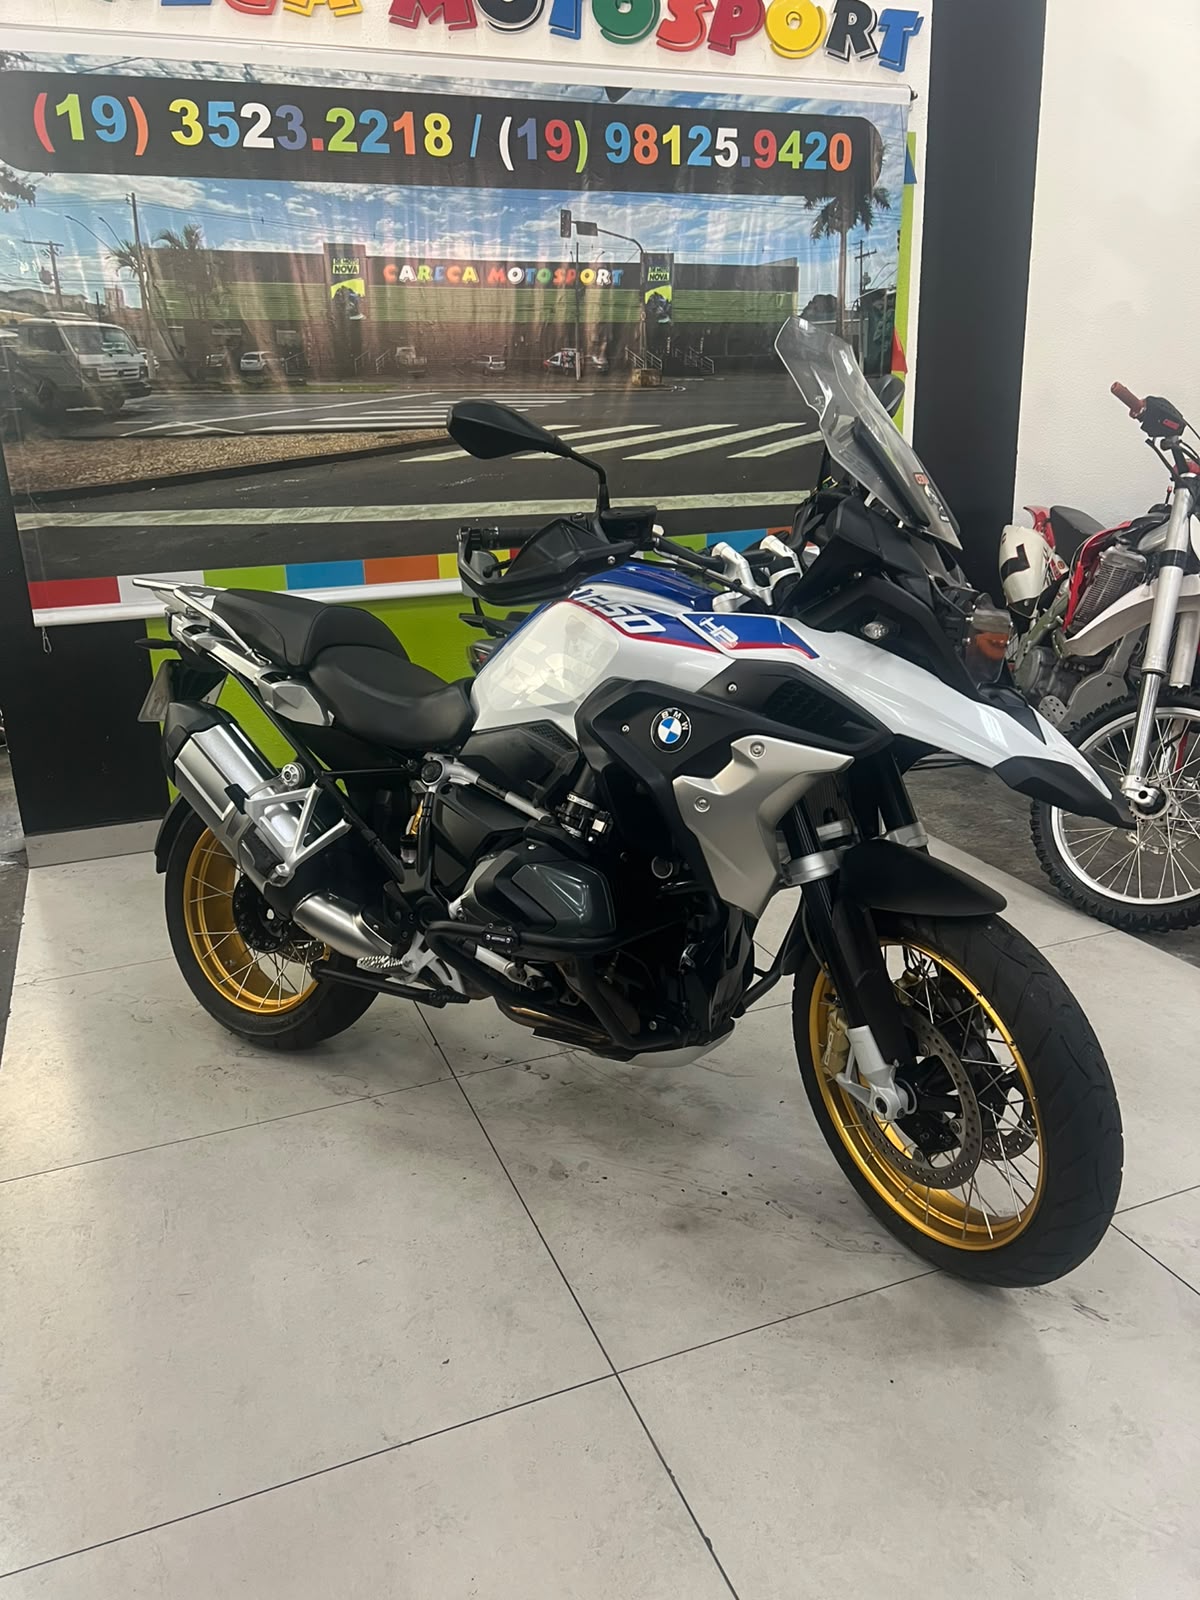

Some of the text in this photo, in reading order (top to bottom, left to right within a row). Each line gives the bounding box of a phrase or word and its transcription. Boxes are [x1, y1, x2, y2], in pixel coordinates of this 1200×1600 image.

[33, 92, 852, 173] (19) 3523.2218 / (19) 98125.9420
[334, 265, 359, 273] NOVA
[383, 263, 624, 286] CARECA MOTOSPORT
[649, 272, 669, 280] NOVA
[661, 710, 689, 730] BMW
